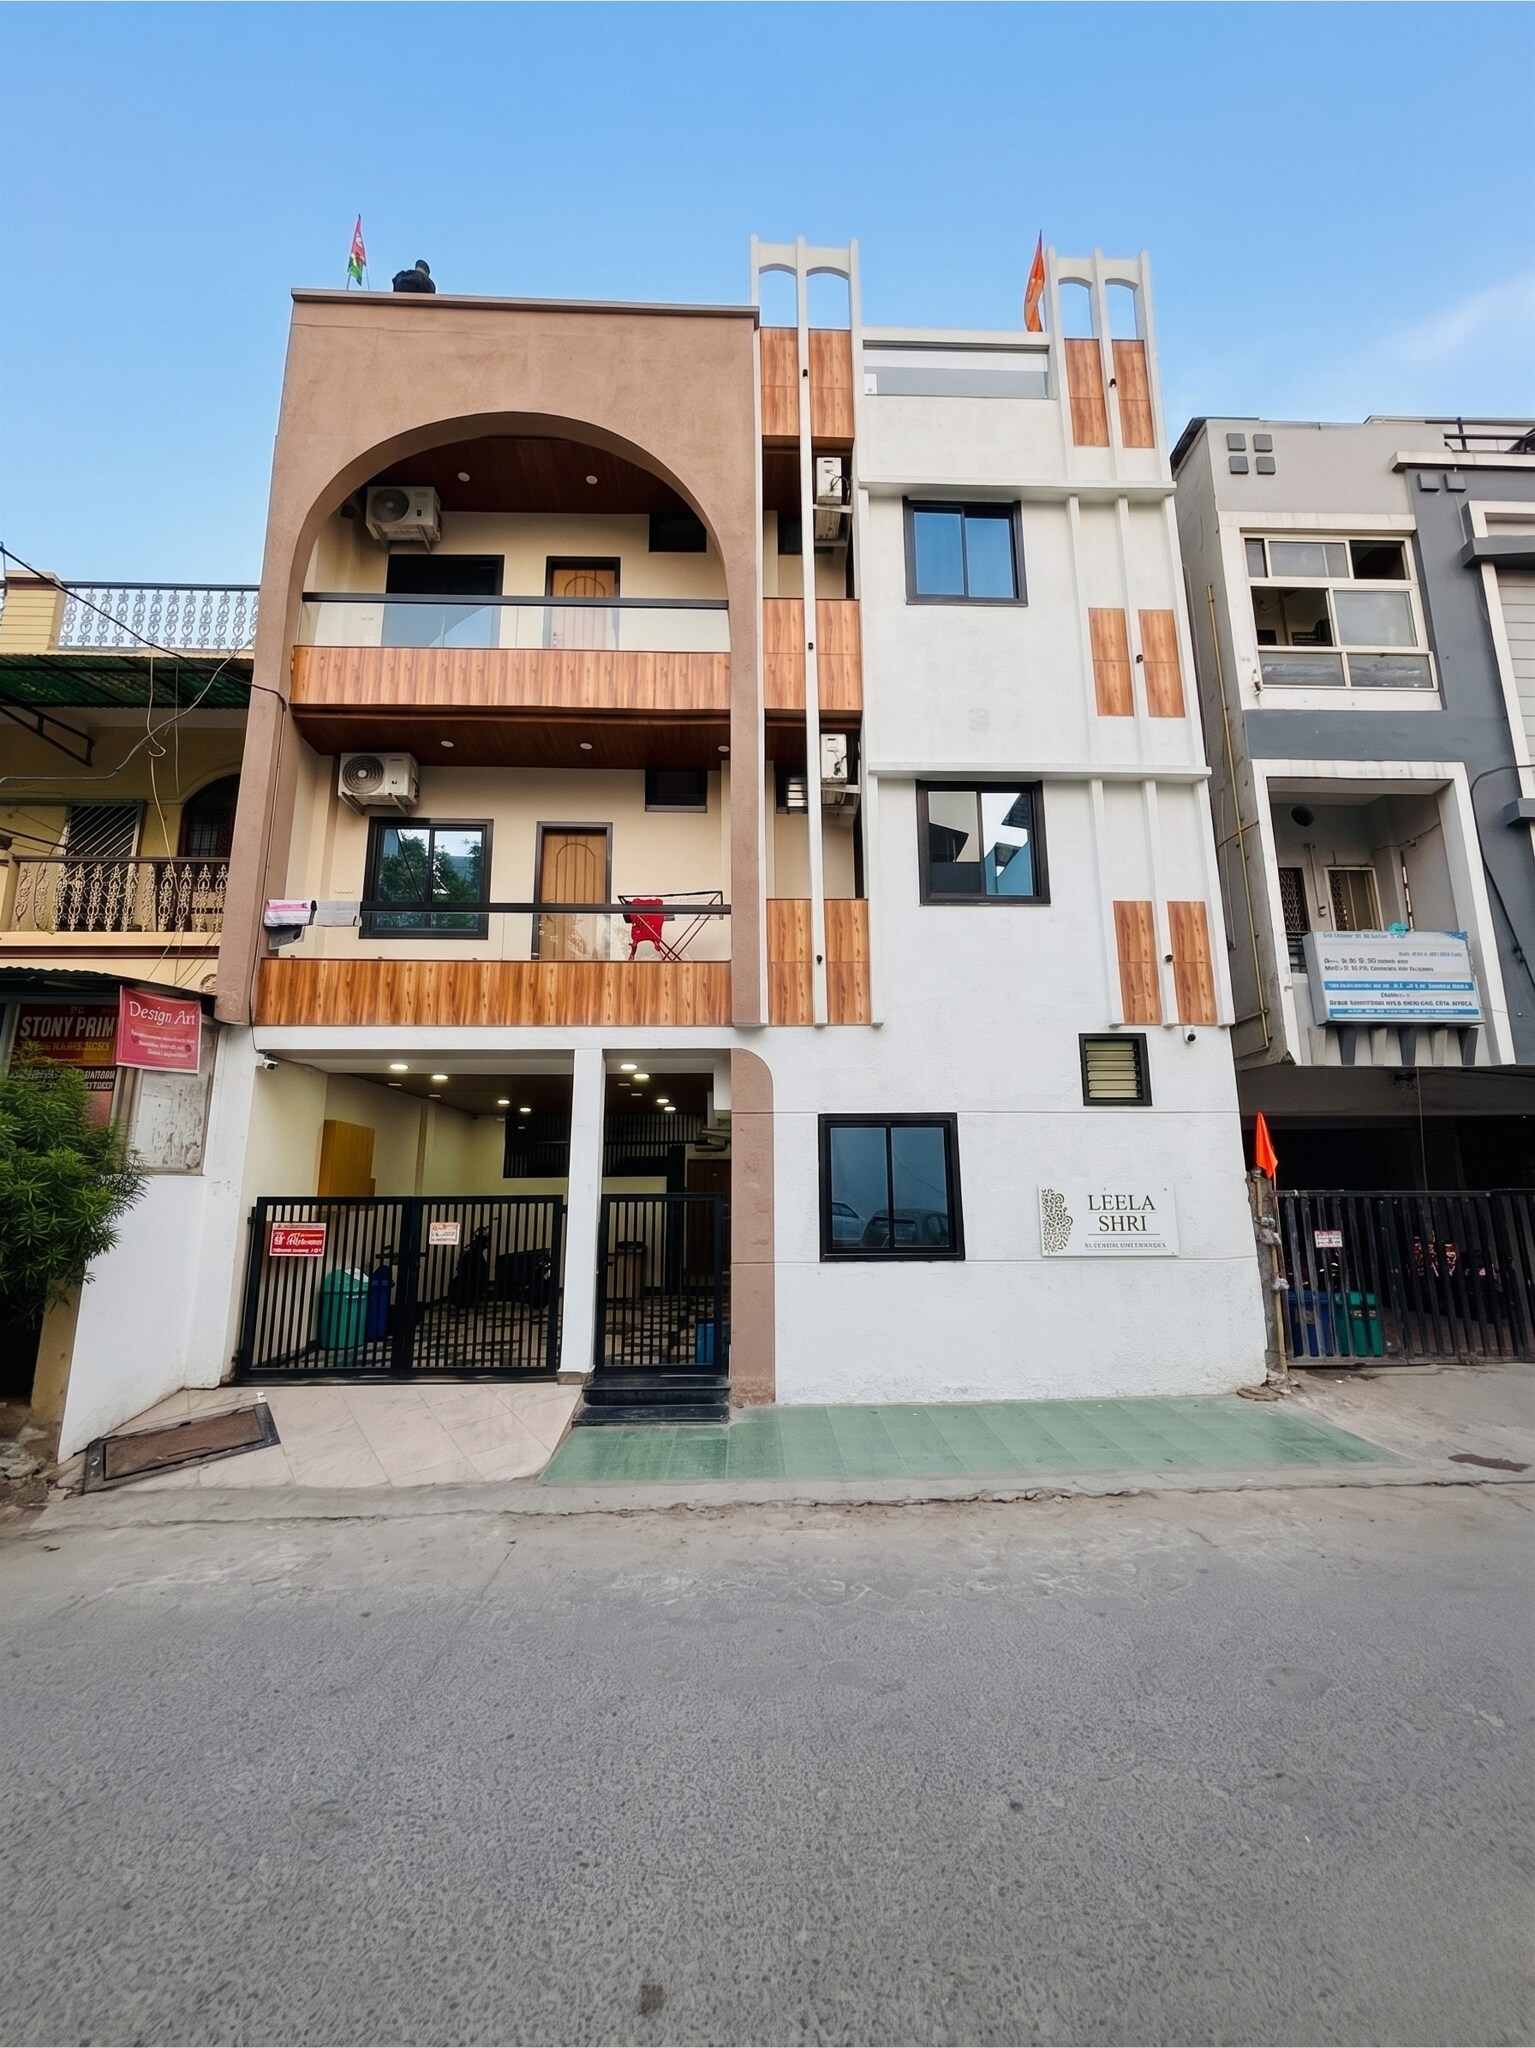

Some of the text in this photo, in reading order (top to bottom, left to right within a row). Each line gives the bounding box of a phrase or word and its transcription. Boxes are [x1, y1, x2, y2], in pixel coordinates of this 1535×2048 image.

[129, 1001, 196, 1026] Design Art
[19, 1016, 74, 1038] STONY
[1087, 1194, 1156, 1211] LEELA
[1098, 1215, 1148, 1232] SHRI
